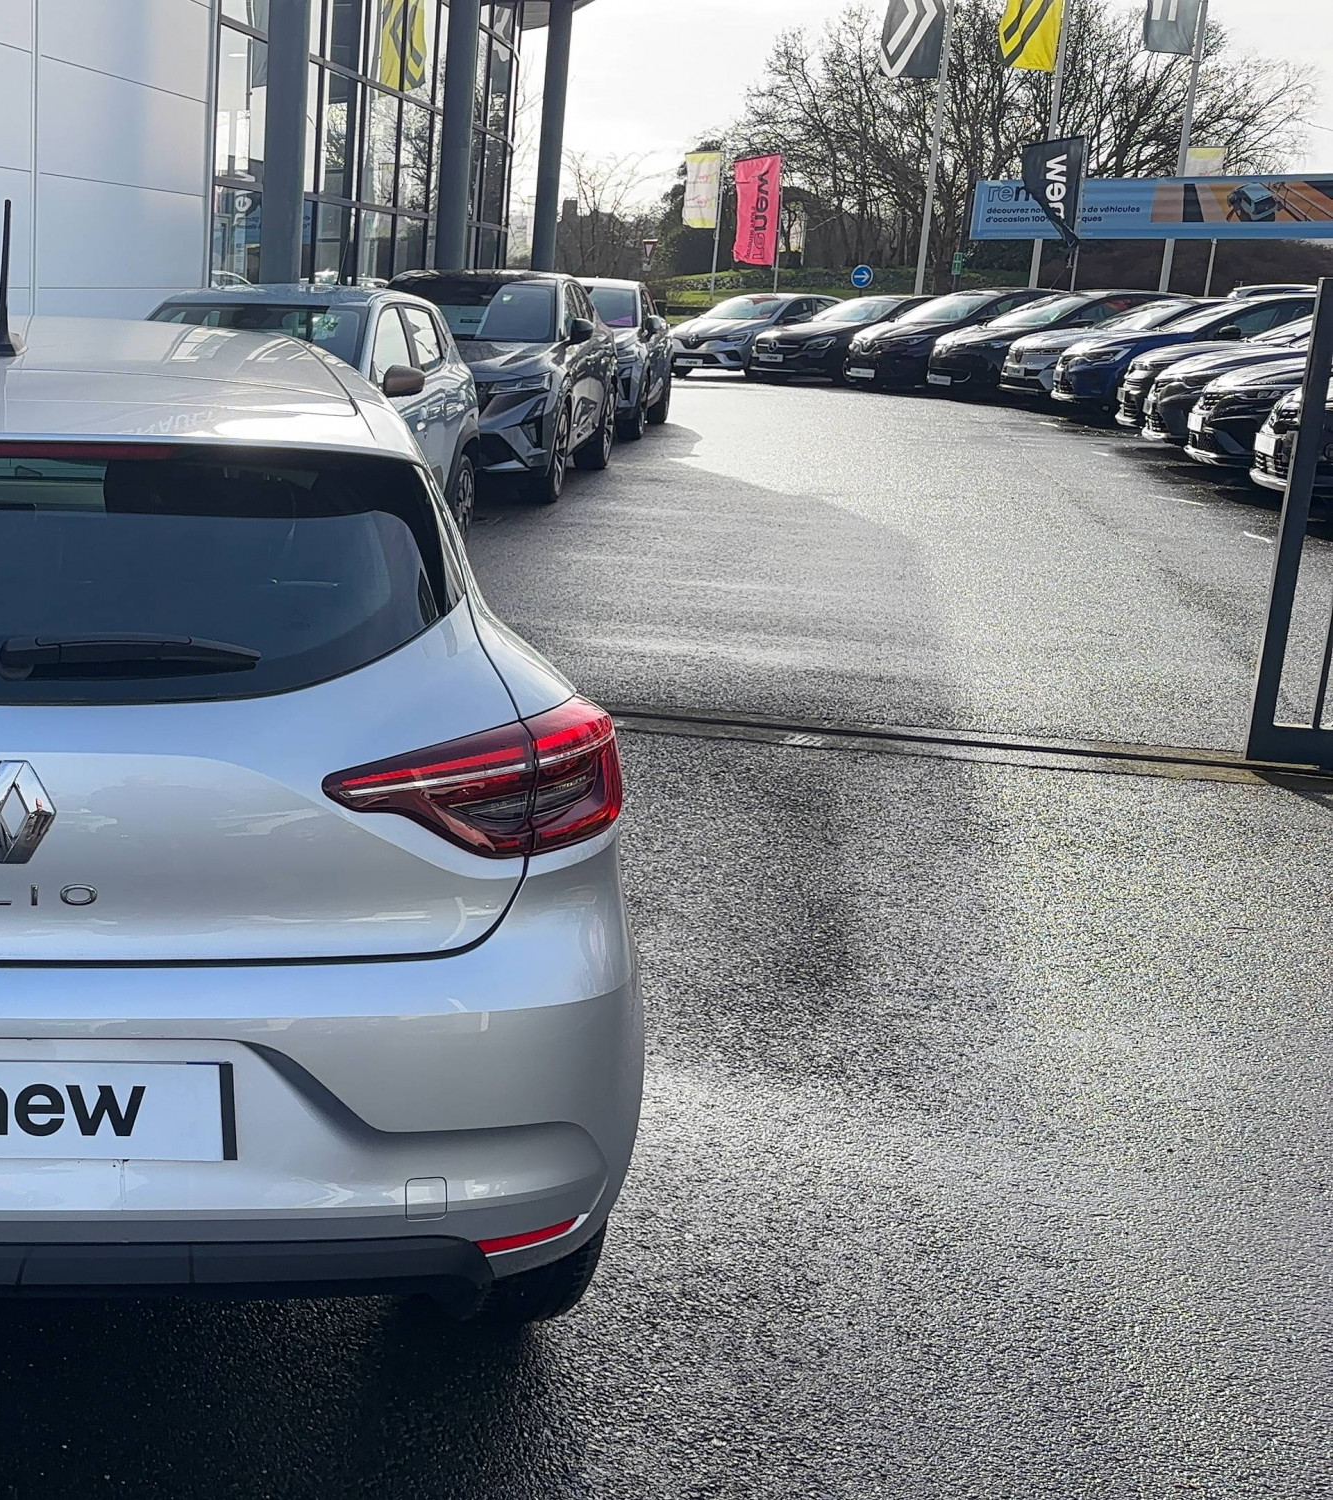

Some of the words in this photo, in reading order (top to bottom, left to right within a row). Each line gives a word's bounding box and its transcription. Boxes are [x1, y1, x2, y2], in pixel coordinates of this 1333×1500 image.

[986, 205, 1029, 214] découvrez
[1099, 205, 1141, 213] véhicules
[985, 215, 1031, 223] d'occasion
